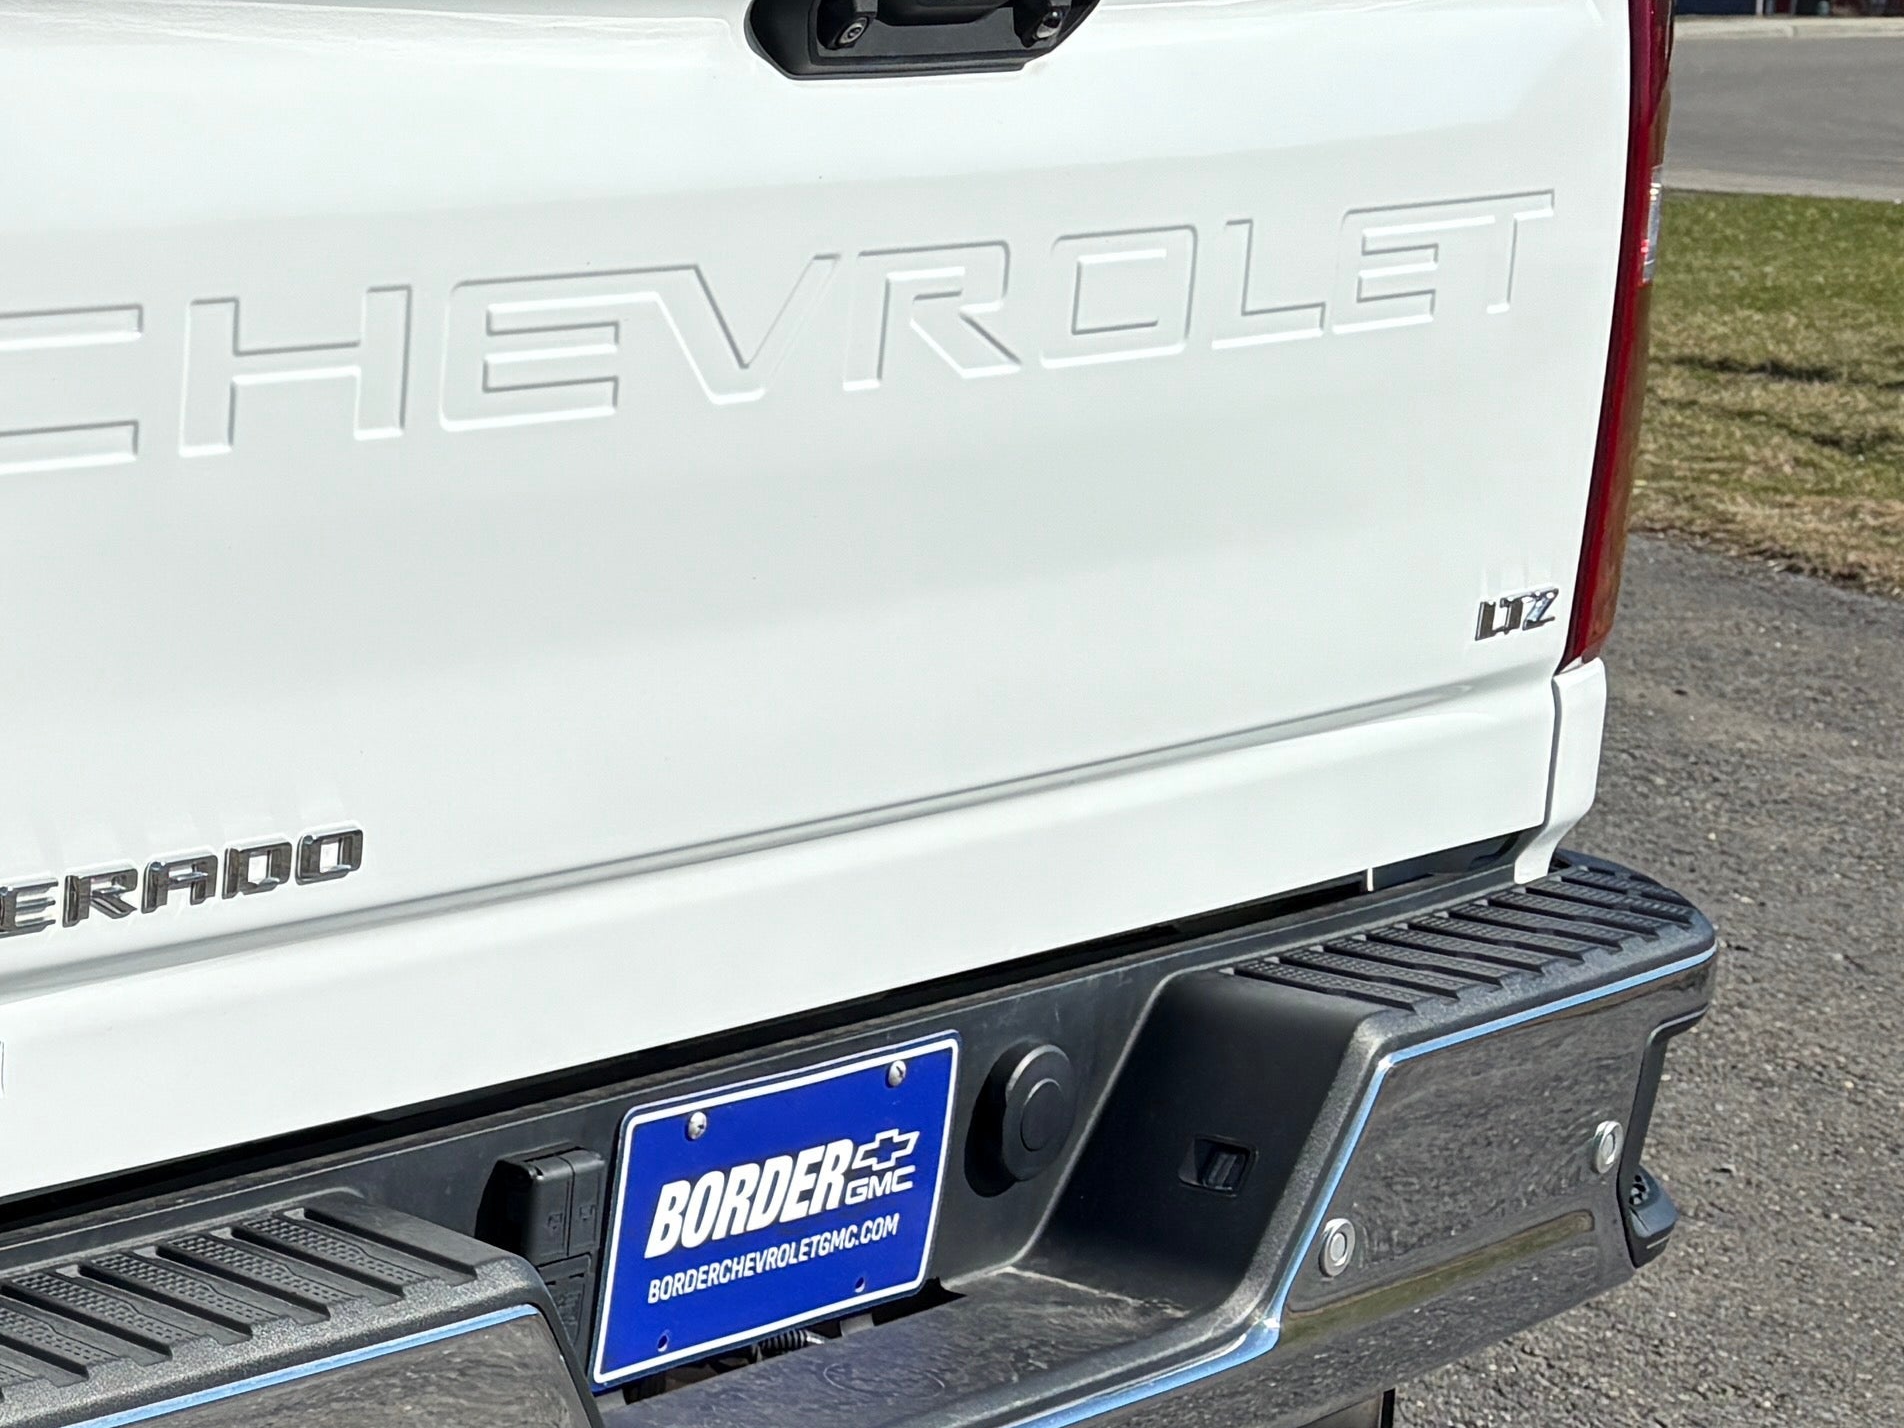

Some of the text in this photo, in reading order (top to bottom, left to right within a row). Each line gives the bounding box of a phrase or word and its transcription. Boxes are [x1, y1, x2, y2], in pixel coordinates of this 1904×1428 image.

[1475, 586, 1559, 642] LTZ
[644, 1138, 854, 1258] BORDER
[844, 1165, 916, 1206] GMC
[647, 1213, 900, 1303] BORDERCHEVROLETGMC.COM
